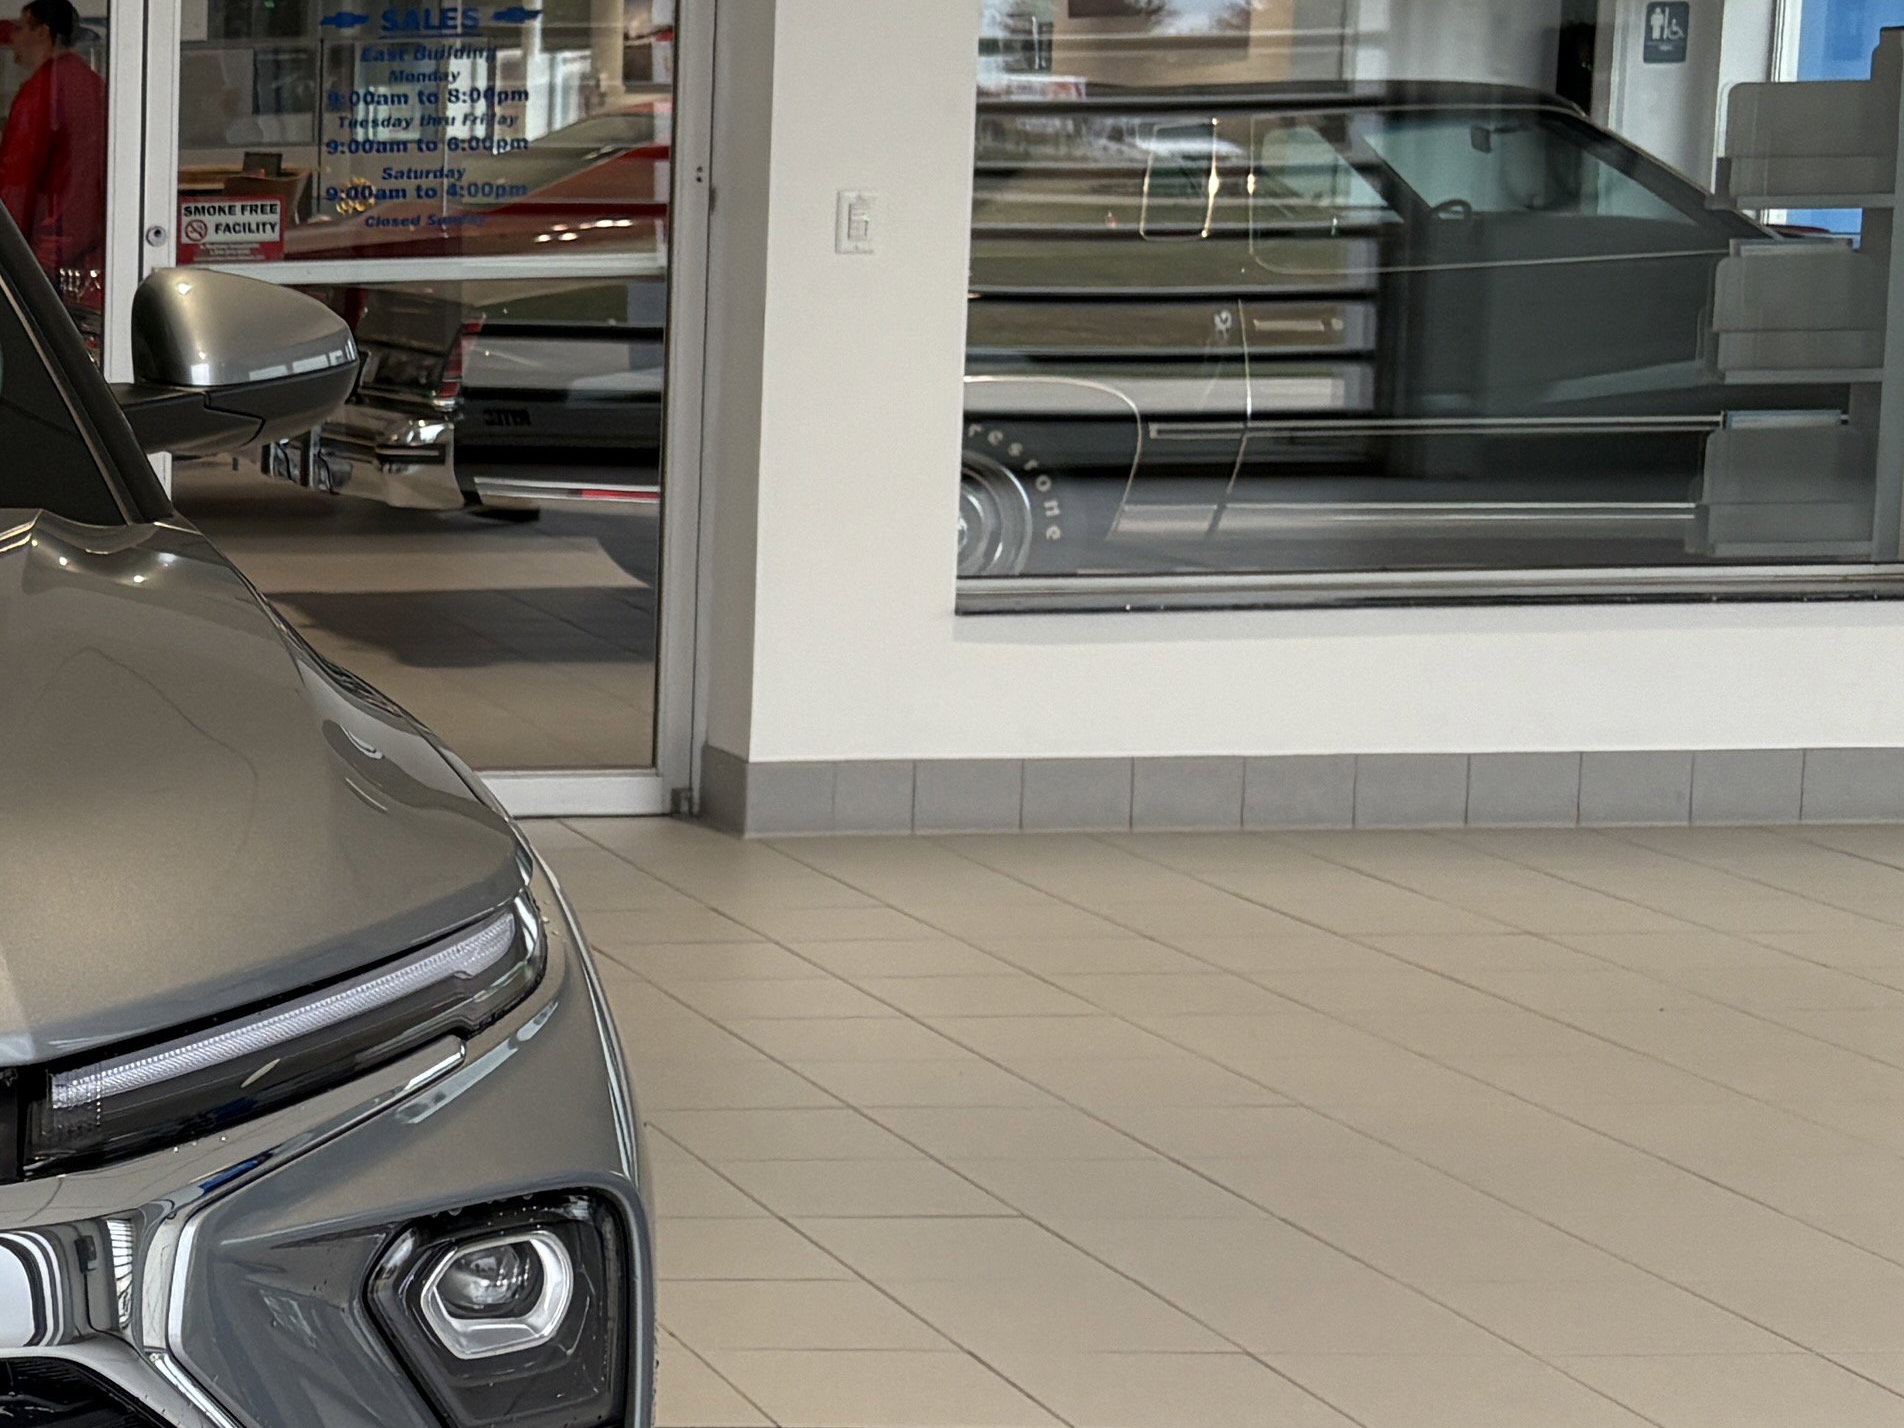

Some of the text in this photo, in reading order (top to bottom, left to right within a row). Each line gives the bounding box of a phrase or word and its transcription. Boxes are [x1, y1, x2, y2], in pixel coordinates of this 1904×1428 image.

[381, 8, 480, 31] SALES
[360, 46, 408, 63] East
[389, 70, 460, 85] Monday
[417, 89, 439, 106] to
[447, 87, 530, 106] 8:00pm
[339, 115, 414, 131] Tuesday
[326, 136, 529, 155] 9:00am to 6:00pm
[382, 166, 466, 182] Saturday
[326, 182, 528, 202] 9:00am to 4:00pm
[184, 203, 278, 218] SMOKE FREE
[214, 222, 278, 235] FACILITY
[365, 215, 421, 229] Closed
